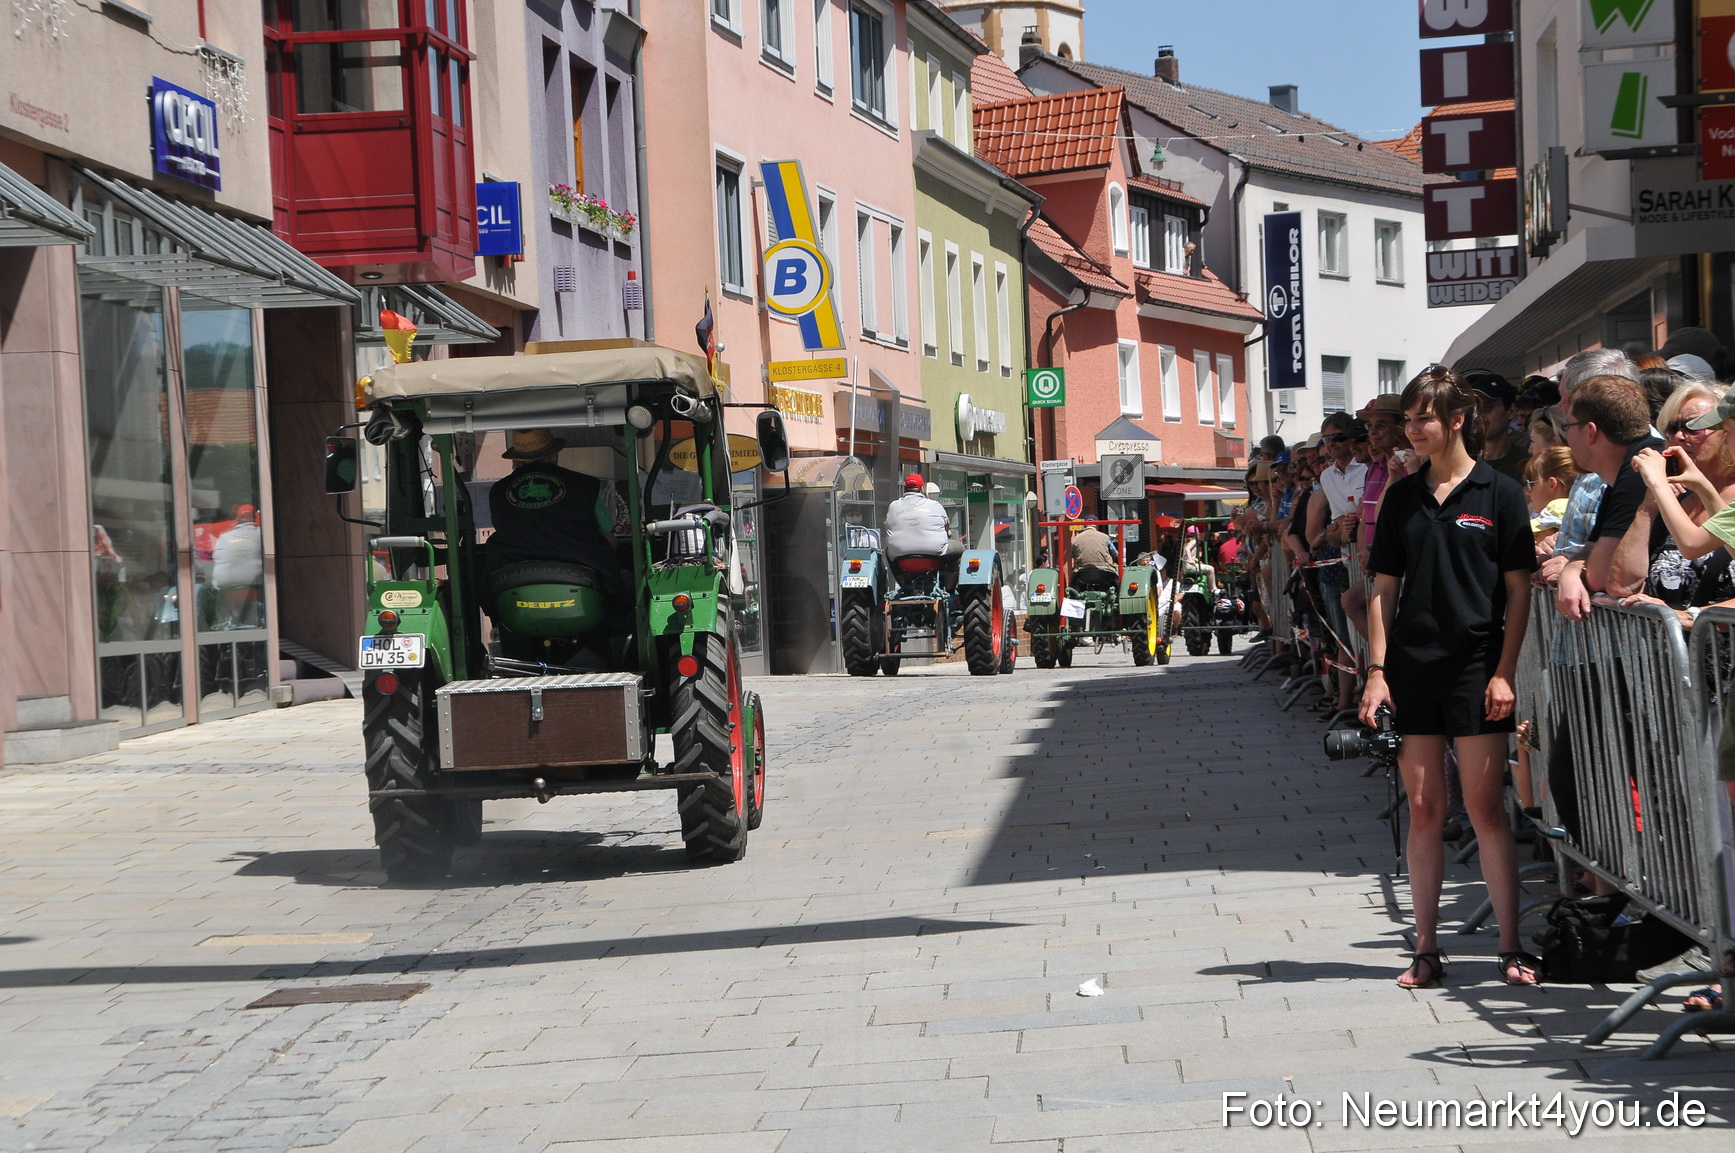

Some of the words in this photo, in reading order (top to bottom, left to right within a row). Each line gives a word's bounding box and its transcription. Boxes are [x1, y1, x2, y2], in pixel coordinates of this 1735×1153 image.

[9, 91, 62, 129] Klostergasse
[64, 113, 69, 133] 2
[164, 90, 220, 158] CECIL
[1639, 188, 1713, 213] SARAH
[477, 205, 511, 225] CIL
[1639, 213, 1669, 224] MODE
[1671, 212, 1679, 222] &
[1289, 227, 1301, 311] TAILOR
[1429, 251, 1514, 280] WITT
[773, 258, 807, 296] B
[1292, 313, 1303, 373] TOM
[772, 363, 834, 376] KLOSTERGASSE
[836, 363, 841, 372] 4
[1108, 440, 1150, 452] Creppresso
[673, 451, 688, 460] DIE
[1112, 487, 1133, 495] ZONE
[516, 599, 576, 608] DEUTZ
[373, 638, 401, 651] HOL
[365, 652, 383, 665] DW
[387, 651, 405, 664] 35
